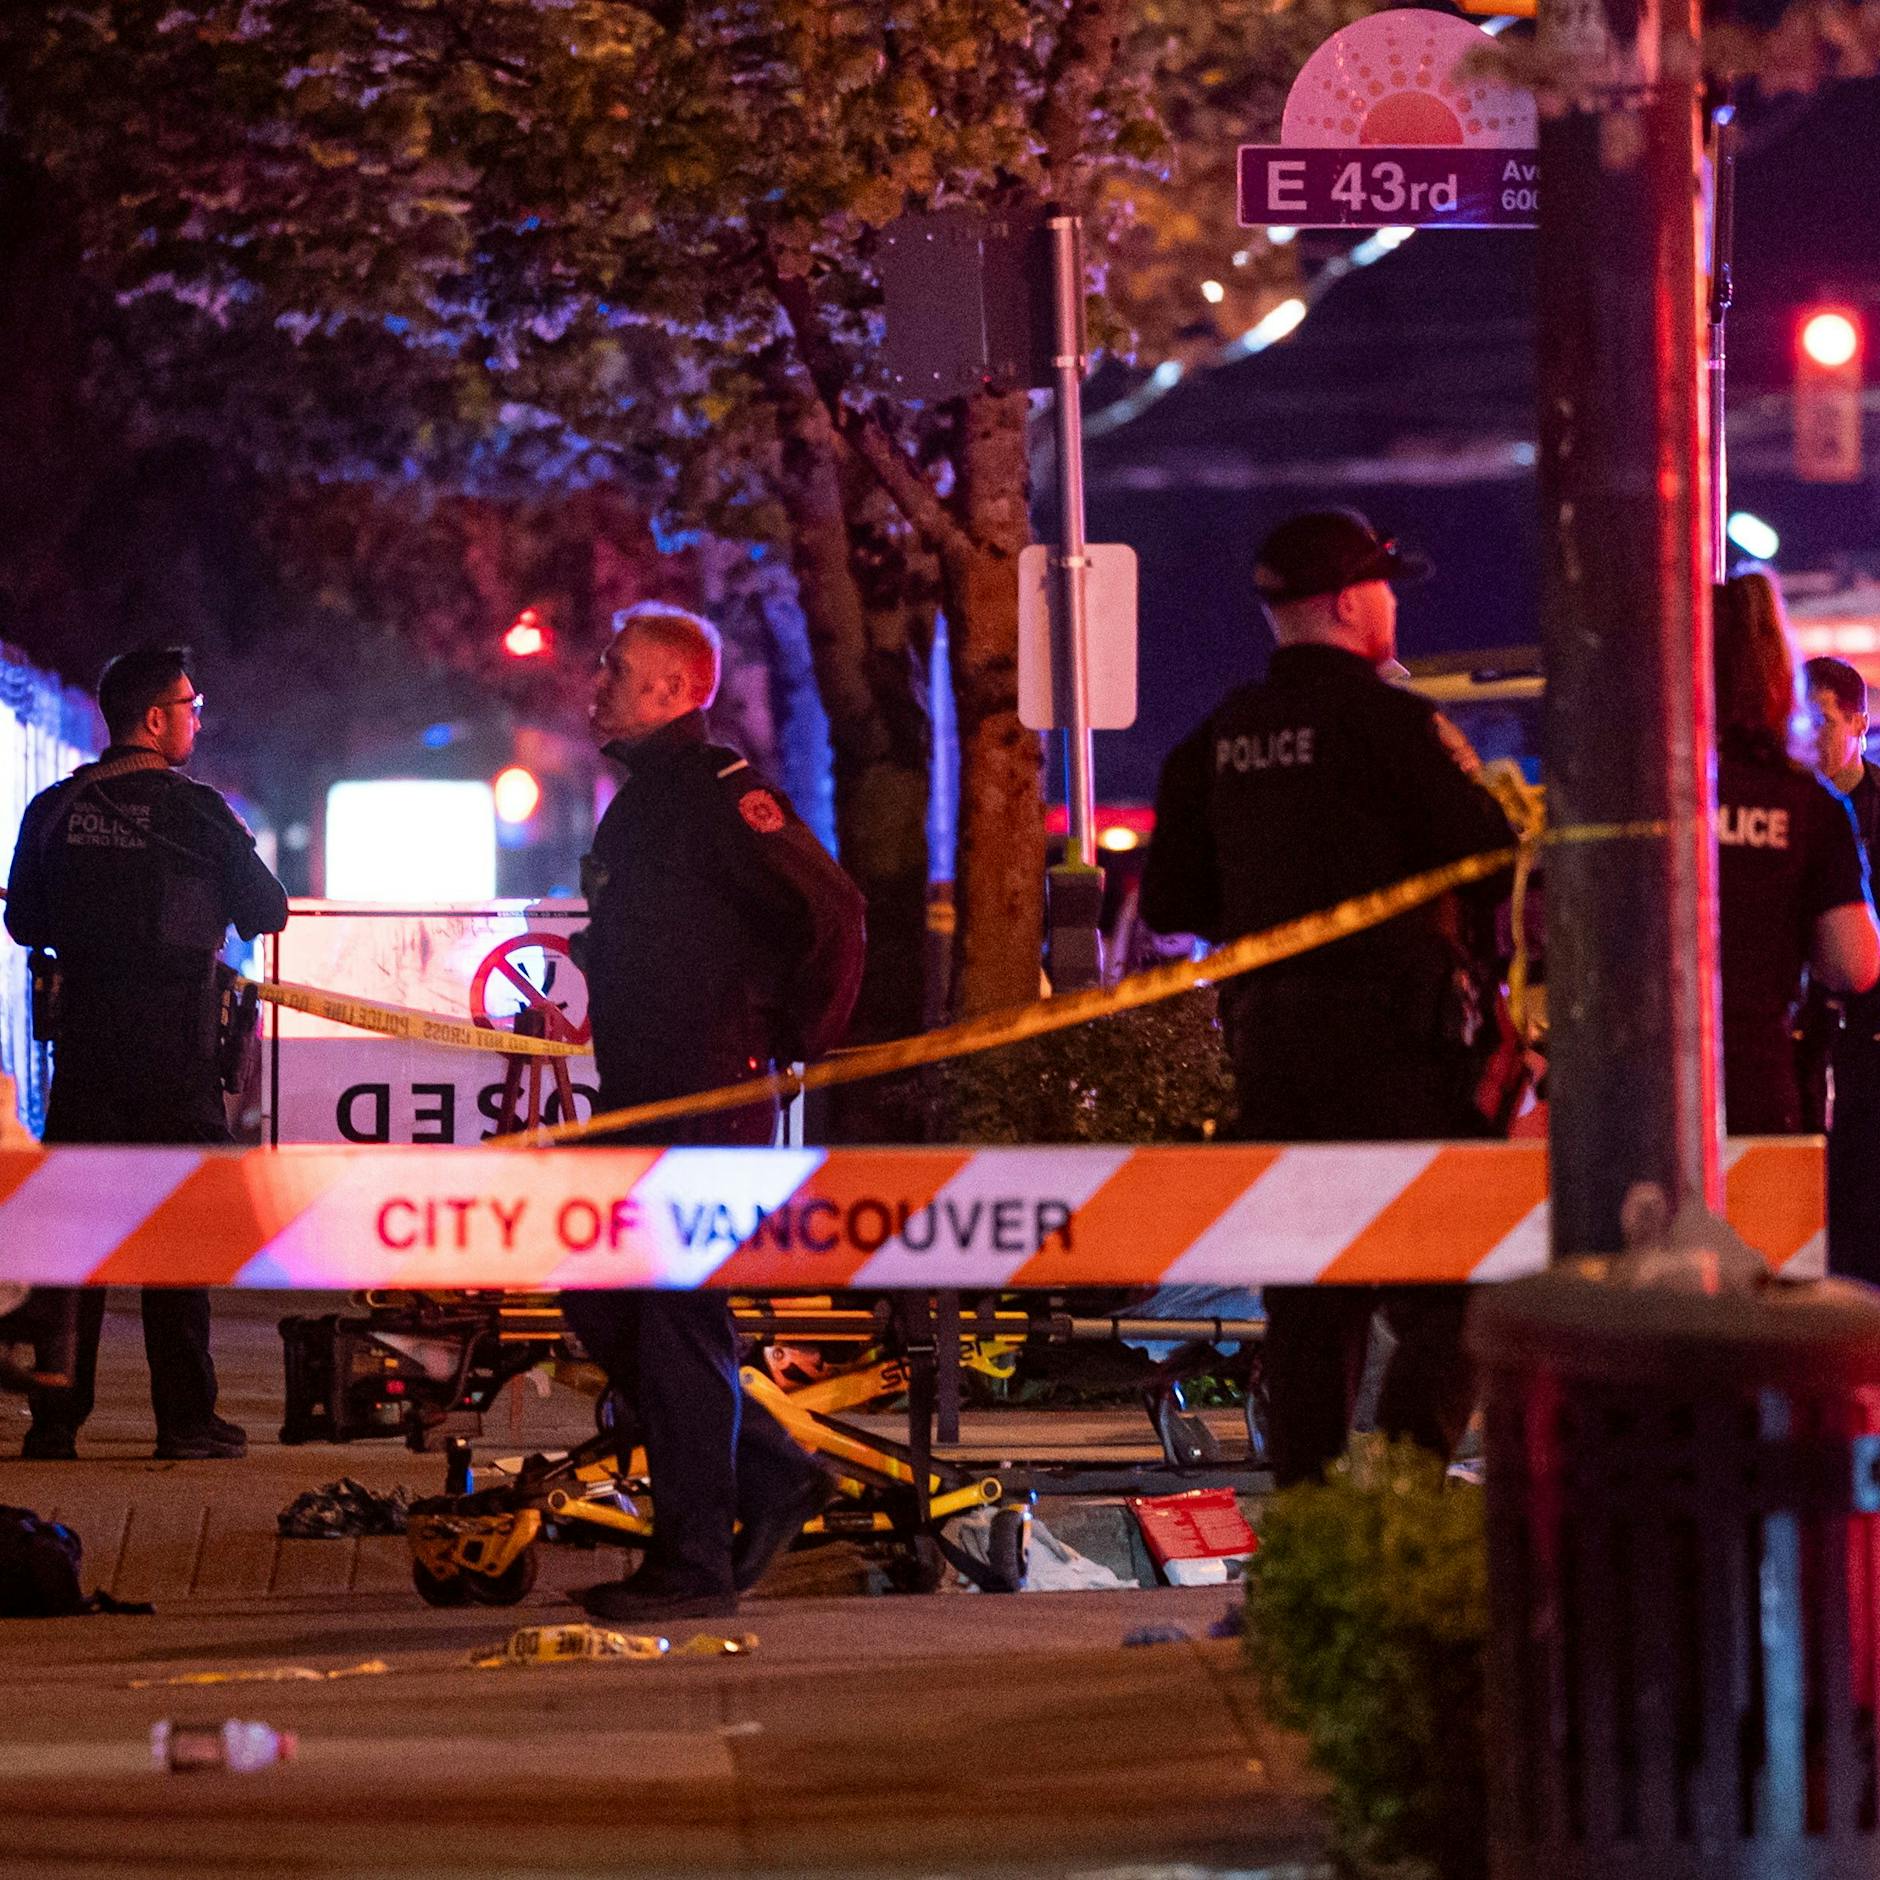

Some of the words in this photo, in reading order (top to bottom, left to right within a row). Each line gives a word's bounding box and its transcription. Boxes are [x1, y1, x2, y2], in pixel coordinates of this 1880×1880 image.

[1266, 160, 1308, 211] E
[1330, 160, 1459, 212] 43rd
[1501, 159, 1541, 182] Av
[1216, 728, 1315, 774] POLICE
[375, 1199, 527, 1252] CITY
[555, 1199, 638, 1250] OF
[668, 1197, 1075, 1255] VANCOUVER
